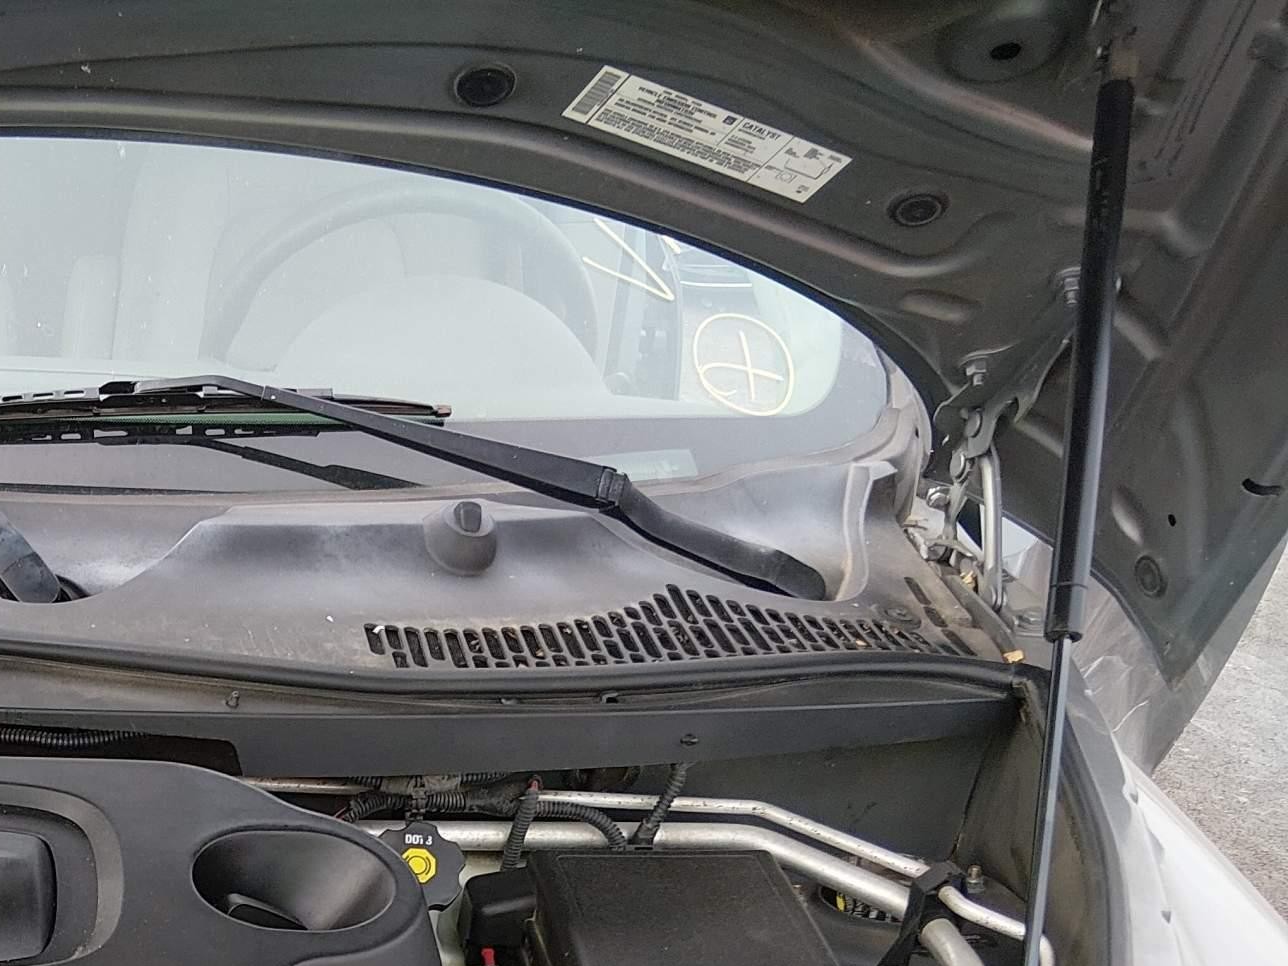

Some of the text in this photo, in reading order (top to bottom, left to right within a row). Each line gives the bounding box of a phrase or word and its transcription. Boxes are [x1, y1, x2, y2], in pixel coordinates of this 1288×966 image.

[742, 121, 782, 141] CATALYST
[405, 834, 433, 845] DOT 3
